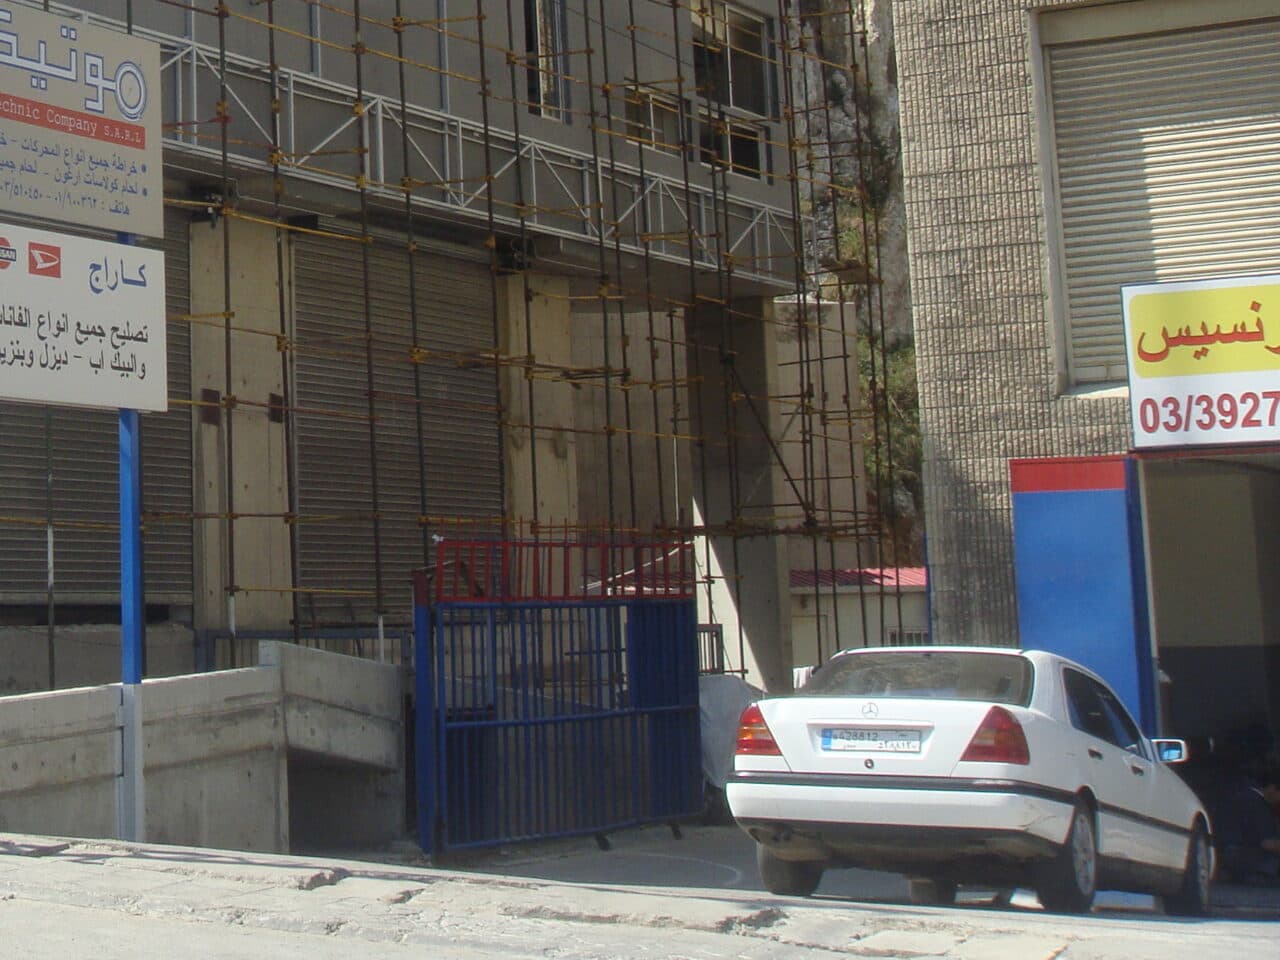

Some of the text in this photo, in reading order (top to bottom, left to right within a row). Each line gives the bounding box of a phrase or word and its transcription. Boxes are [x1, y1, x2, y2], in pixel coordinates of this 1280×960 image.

[46, 110, 97, 137] Company
[36, 310, 69, 341] انواع
[74, 321, 106, 345] جميع
[110, 319, 149, 350] تصليح
[39, 342, 69, 371] ديزل
[1139, 391, 1280, 434] 03/3927
